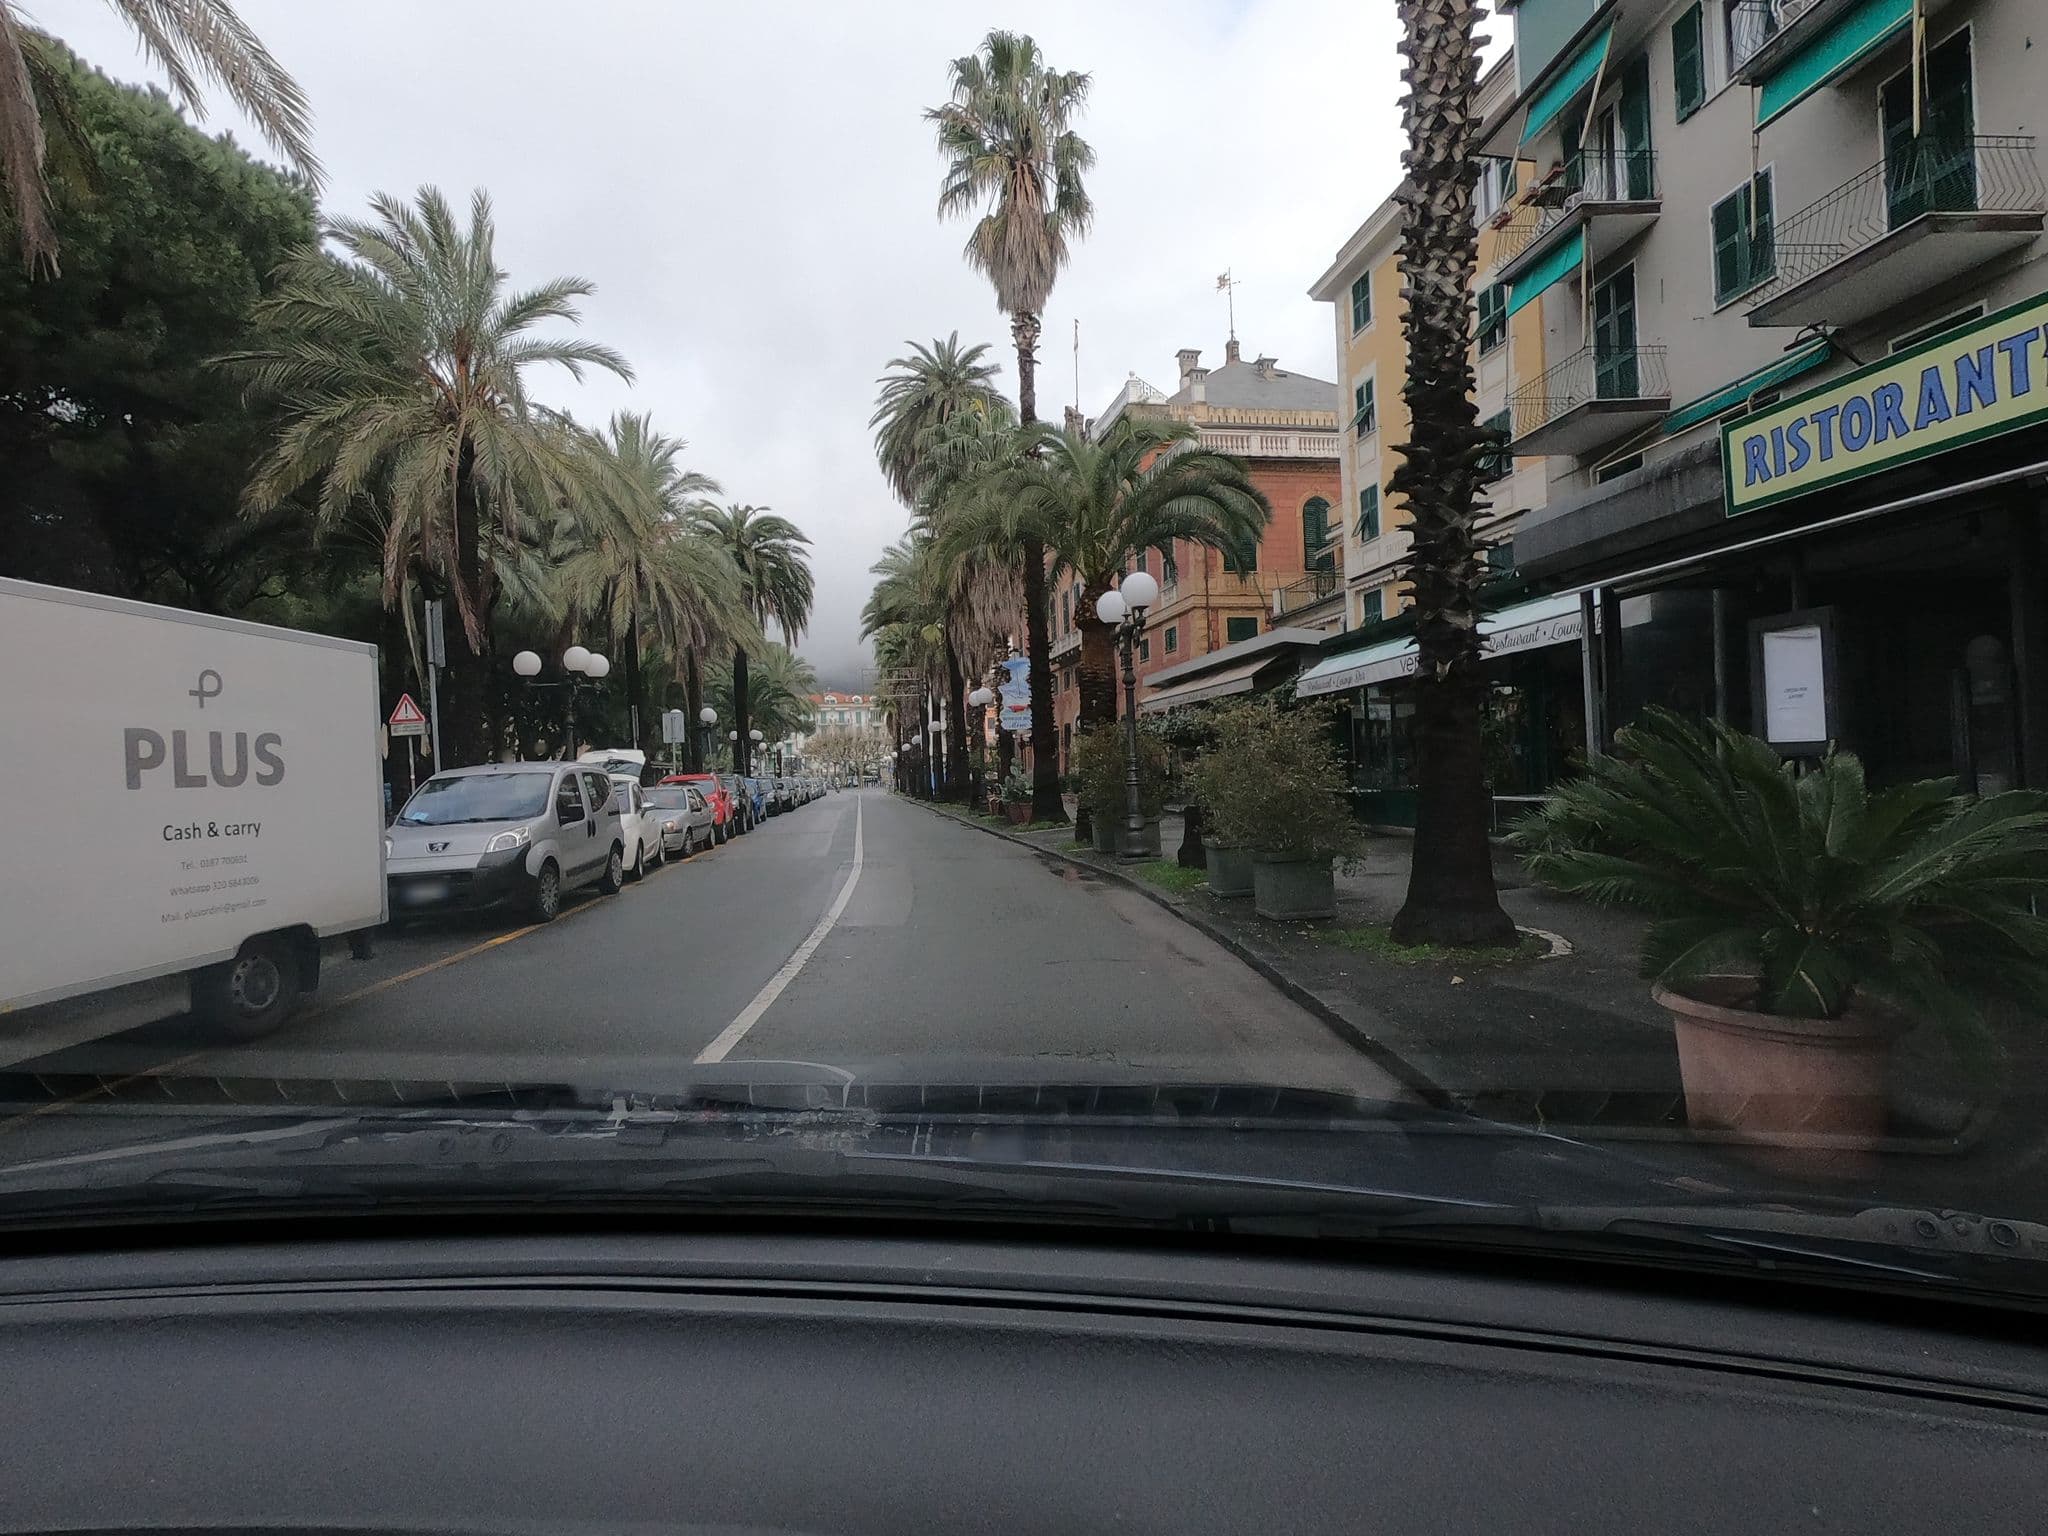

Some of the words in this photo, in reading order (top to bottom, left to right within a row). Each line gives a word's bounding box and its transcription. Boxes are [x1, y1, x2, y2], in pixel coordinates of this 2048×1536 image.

[1742, 322, 2048, 488] RISTORANT
[1548, 621, 1583, 641] Loung
[123, 727, 286, 791] PLUS
[162, 822, 202, 842] Cash
[207, 821, 220, 839] &
[224, 820, 262, 841] carry
